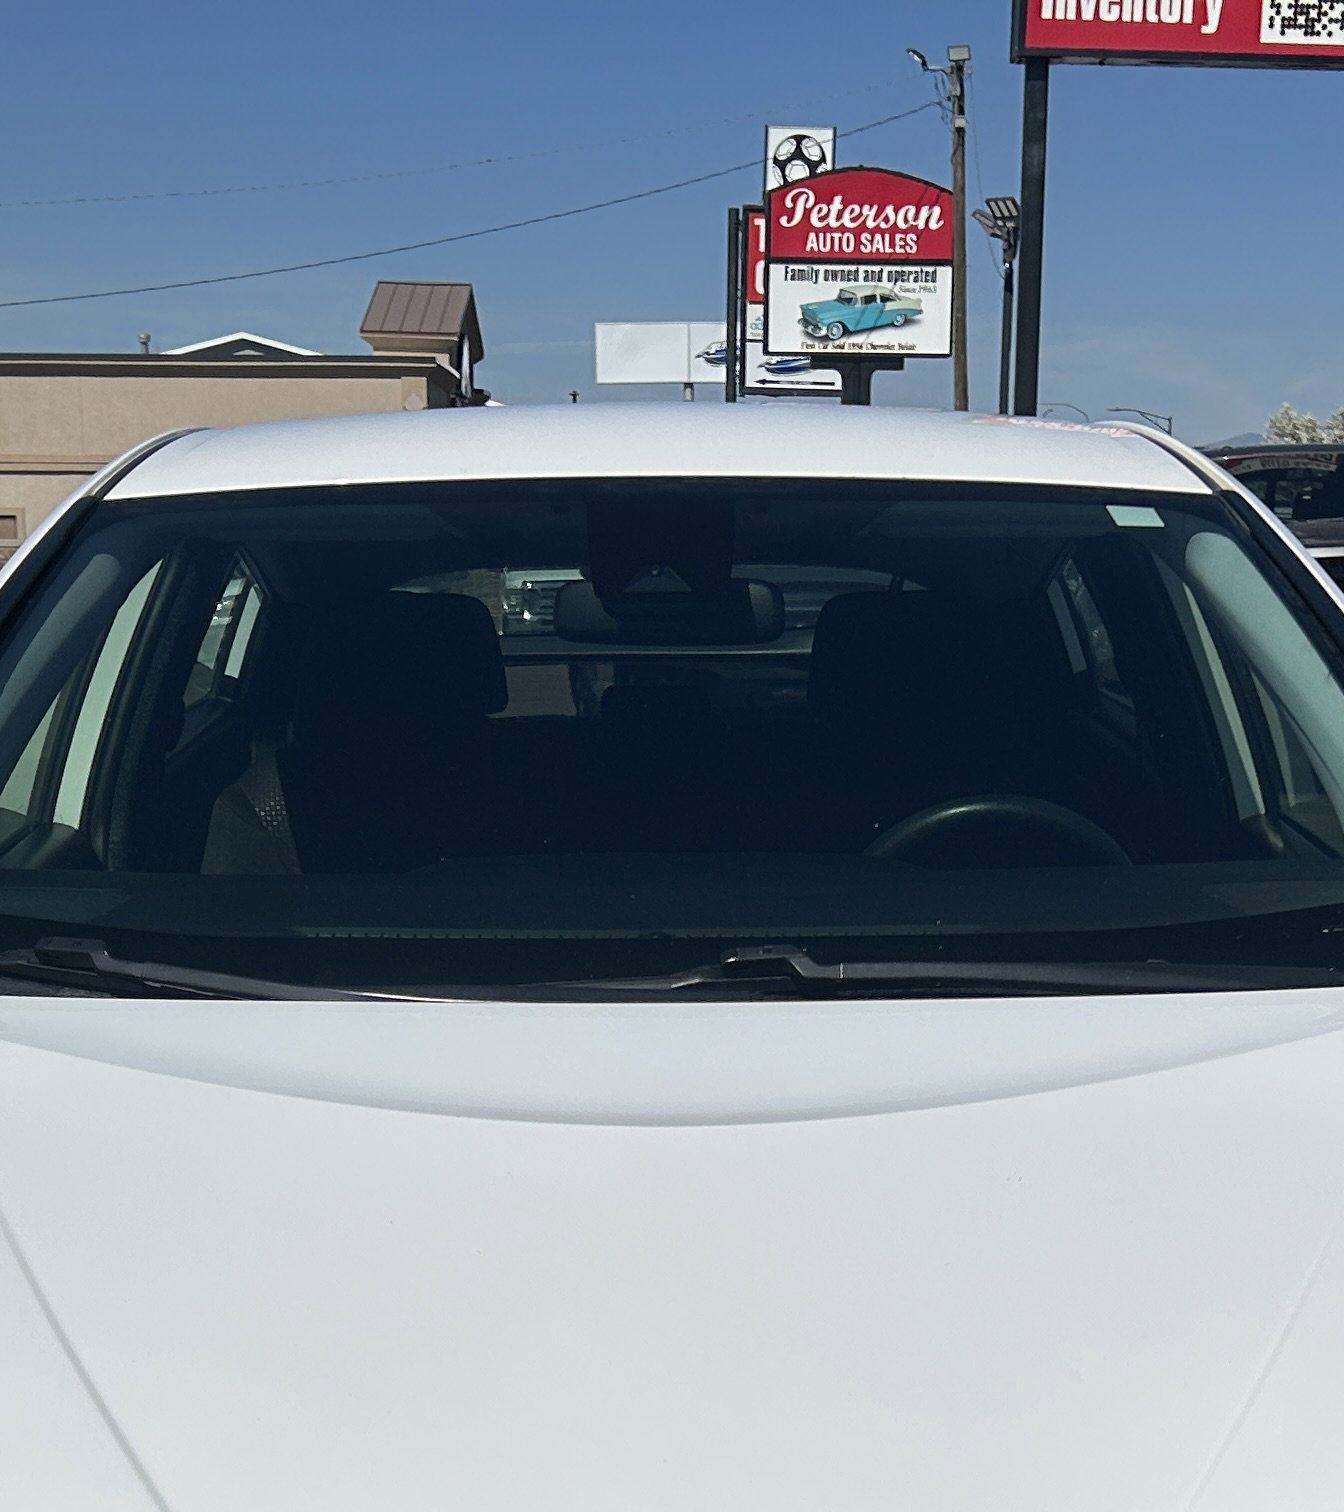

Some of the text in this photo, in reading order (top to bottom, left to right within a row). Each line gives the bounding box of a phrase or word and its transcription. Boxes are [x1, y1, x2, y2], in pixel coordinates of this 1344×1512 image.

[779, 188, 944, 230] Peterson
[806, 232, 918, 254] AUTO SALES
[784, 266, 820, 284] Family
[823, 266, 859, 282] owned
[863, 267, 883, 282] and
[887, 267, 937, 285] operated
